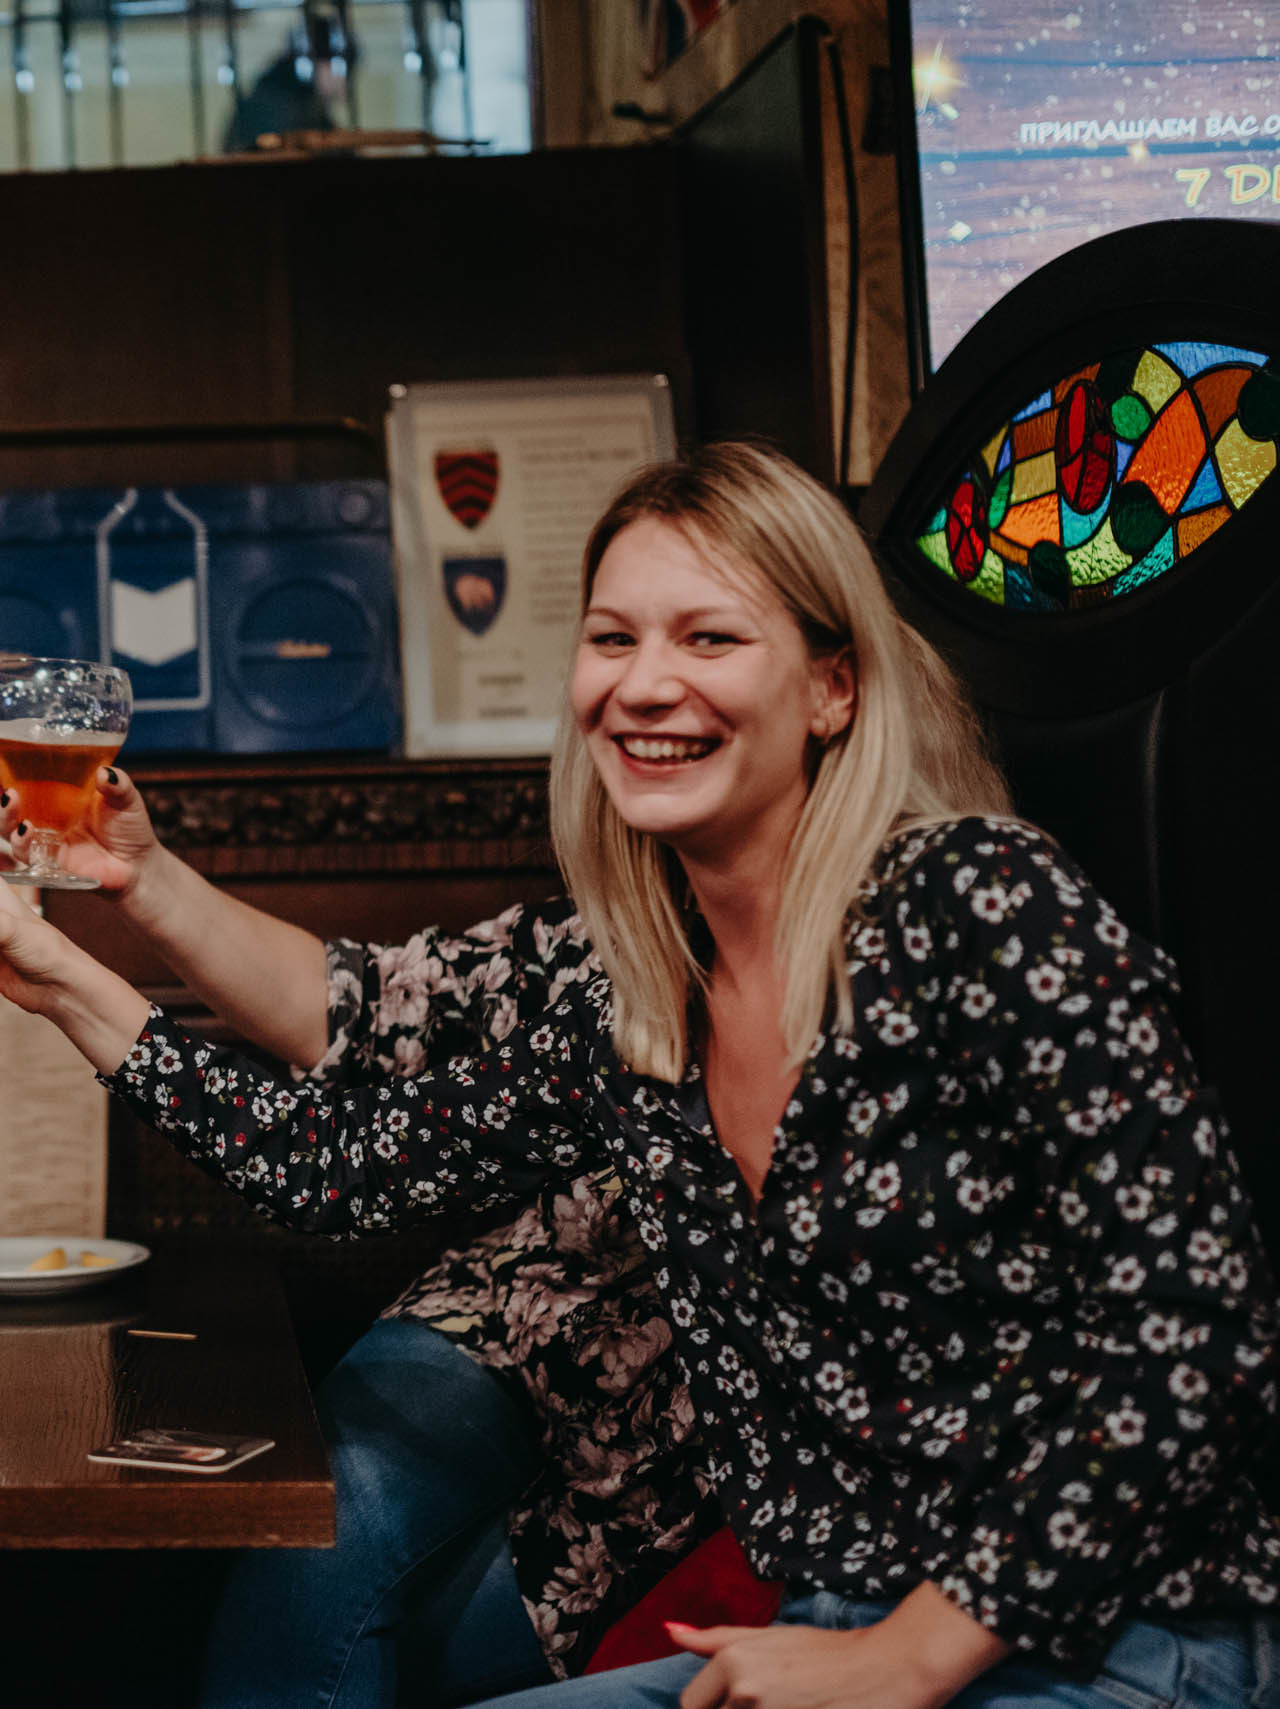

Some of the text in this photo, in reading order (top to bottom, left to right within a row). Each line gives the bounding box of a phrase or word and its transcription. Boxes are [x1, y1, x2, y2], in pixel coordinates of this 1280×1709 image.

[1021, 116, 1197, 144] ПРИГЛАШАЕМ
[1205, 114, 1259, 138] ВАС
[1176, 168, 1210, 208] 7
